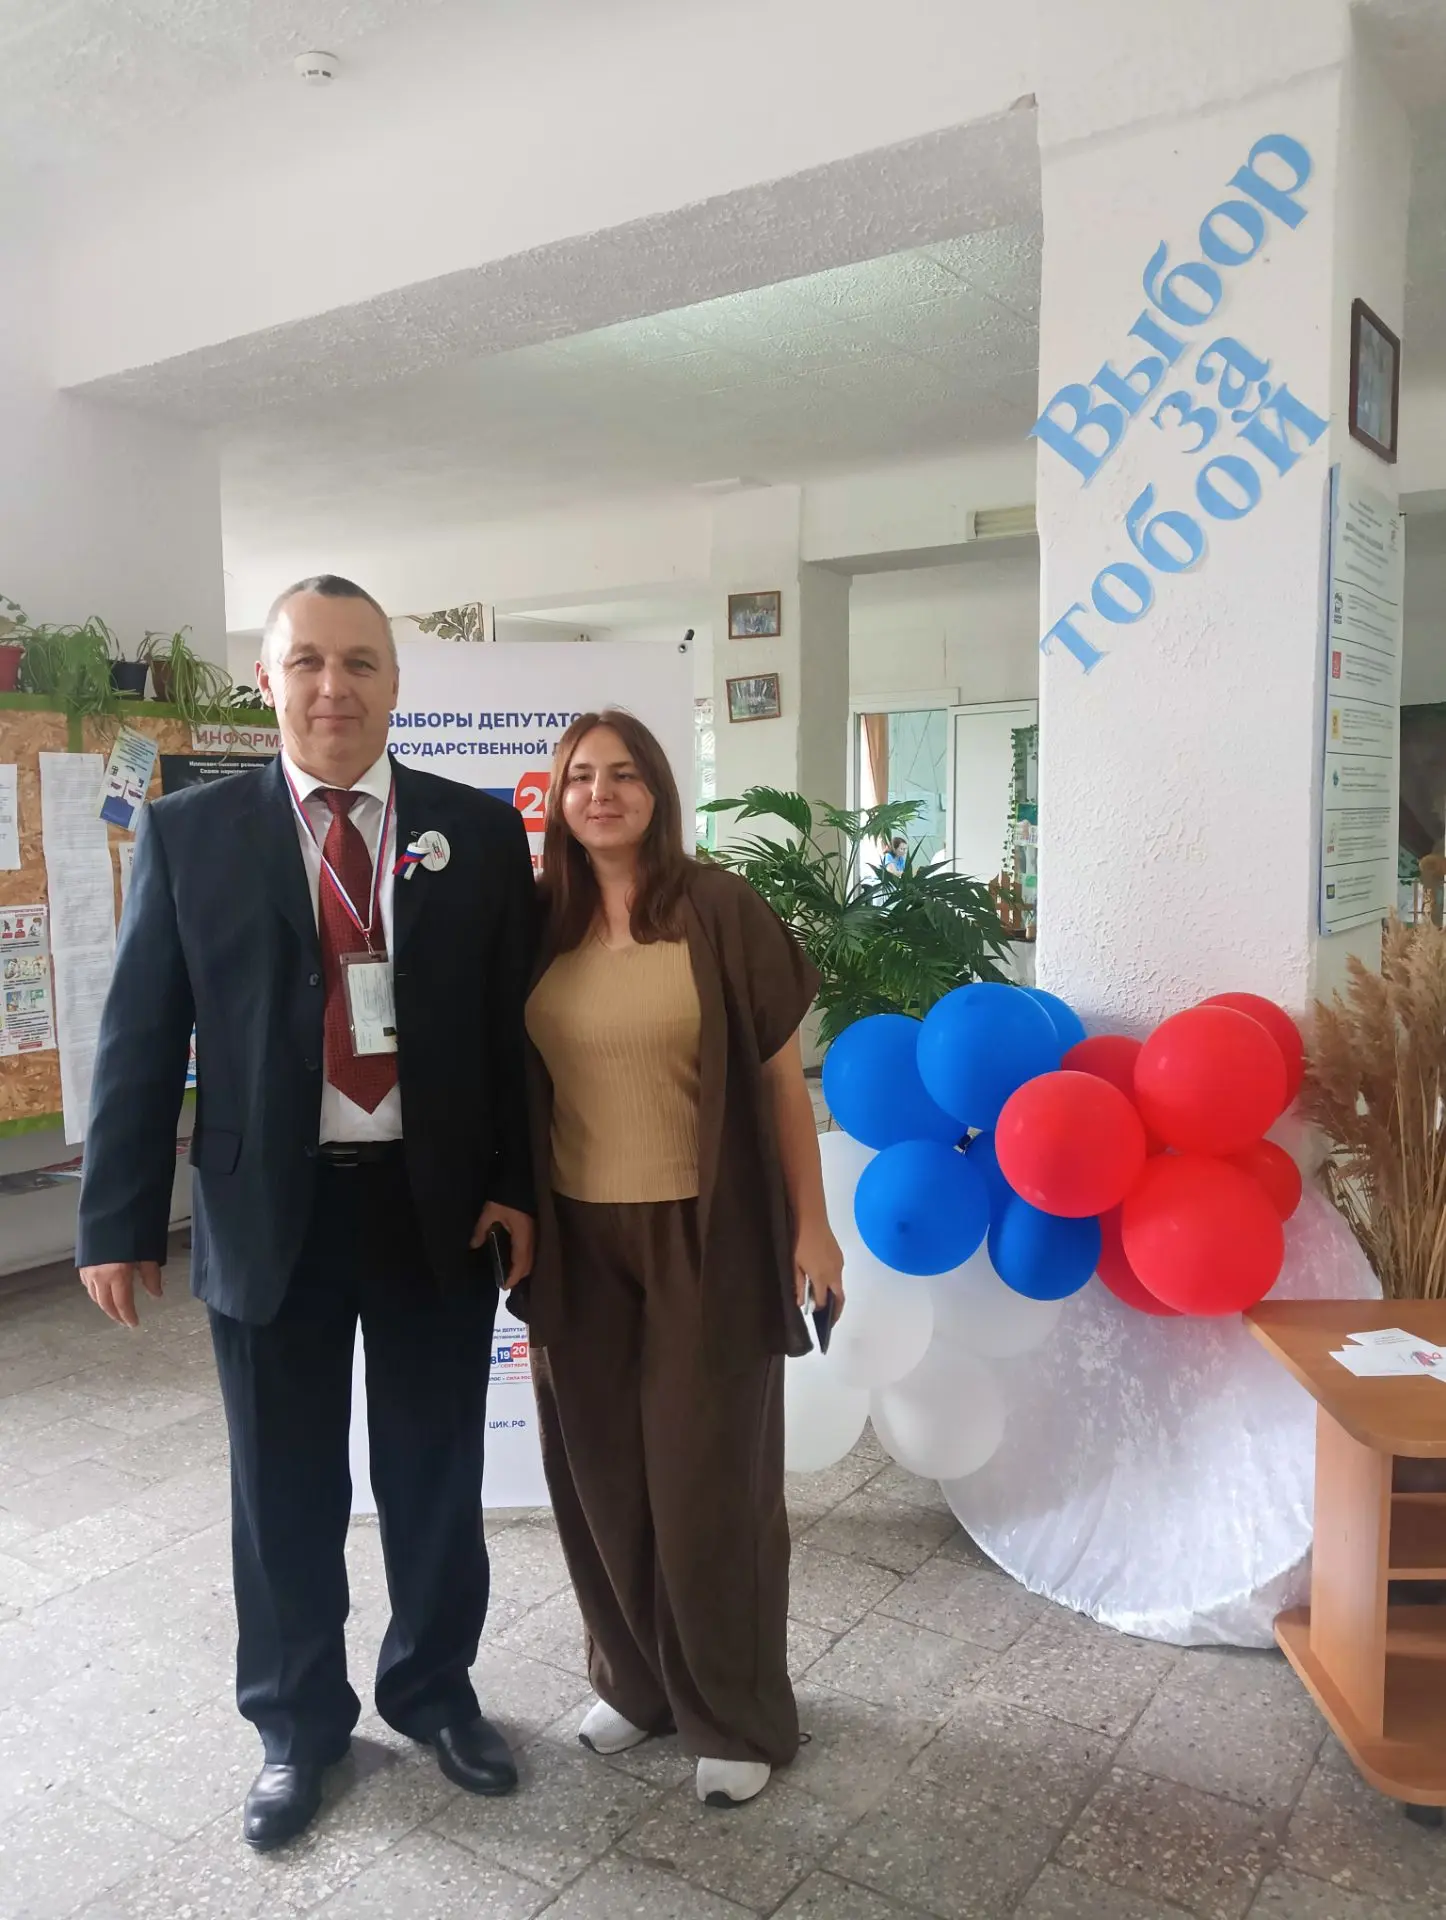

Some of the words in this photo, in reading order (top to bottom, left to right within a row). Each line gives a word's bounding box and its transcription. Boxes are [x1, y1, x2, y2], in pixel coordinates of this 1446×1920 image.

[1028, 133, 1312, 489] Выбор
[1151, 336, 1273, 454] за
[1039, 380, 1331, 675] тобой
[196, 730, 279, 748] ИНФОРМ
[387, 739, 548, 757] ОСУДАРСТВЕННОЙ
[520, 786, 549, 819] 2
[490, 1356, 497, 1365] 8
[499, 1351, 510, 1360] 19
[512, 1345, 526, 1355] 20
[489, 1420, 526, 1429] ЦИК.РФ
